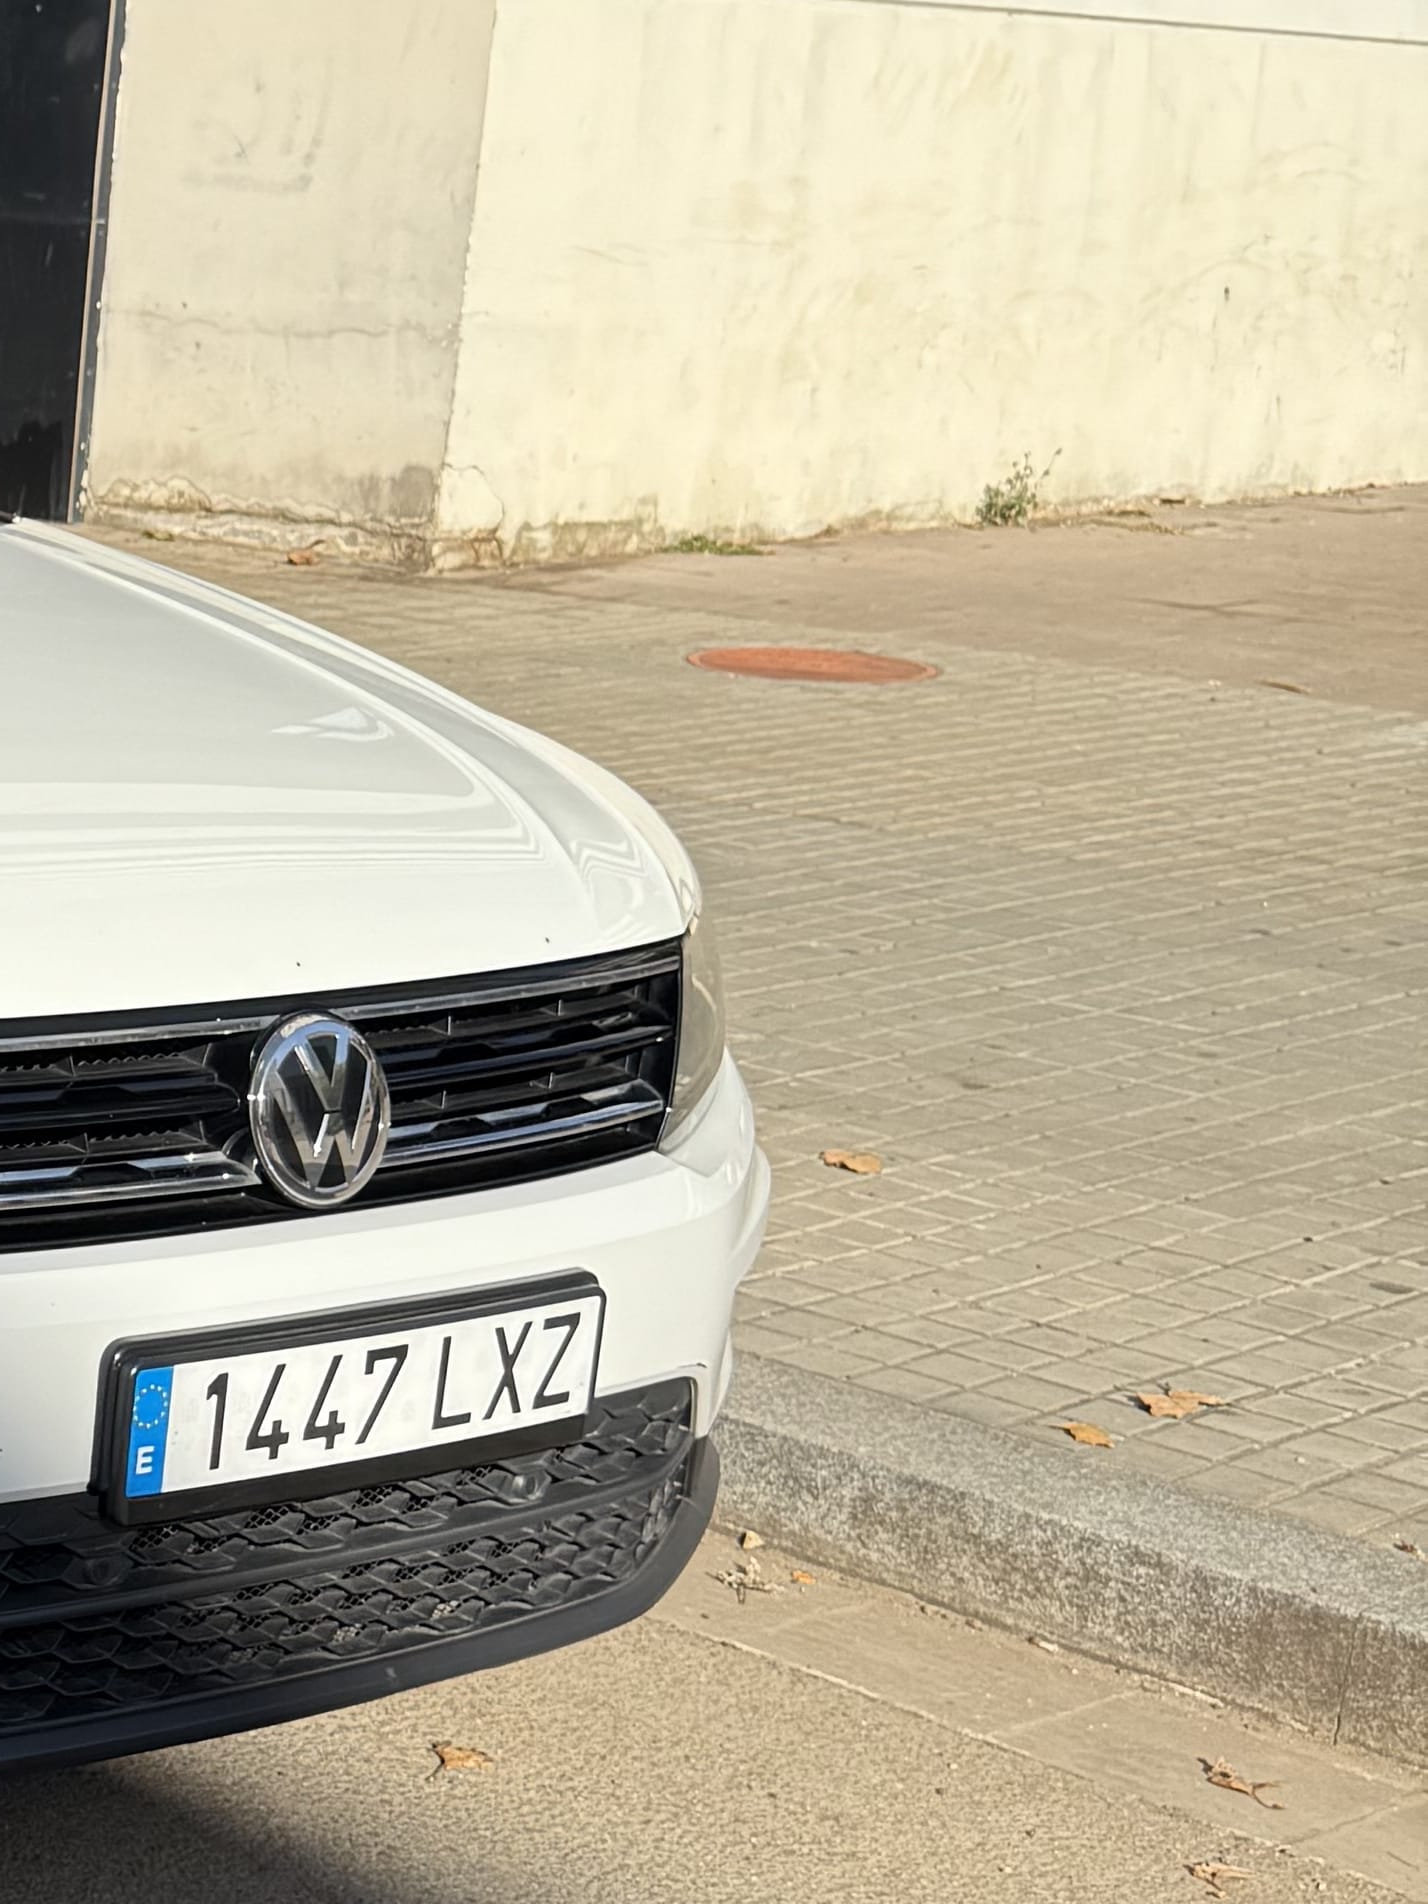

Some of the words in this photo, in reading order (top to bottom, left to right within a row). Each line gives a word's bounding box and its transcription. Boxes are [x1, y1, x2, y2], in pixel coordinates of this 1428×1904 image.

[265, 1026, 379, 1195] VW
[135, 1445, 156, 1475] E
[206, 1342, 409, 1471] 1447
[431, 1312, 582, 1431] LXZ
